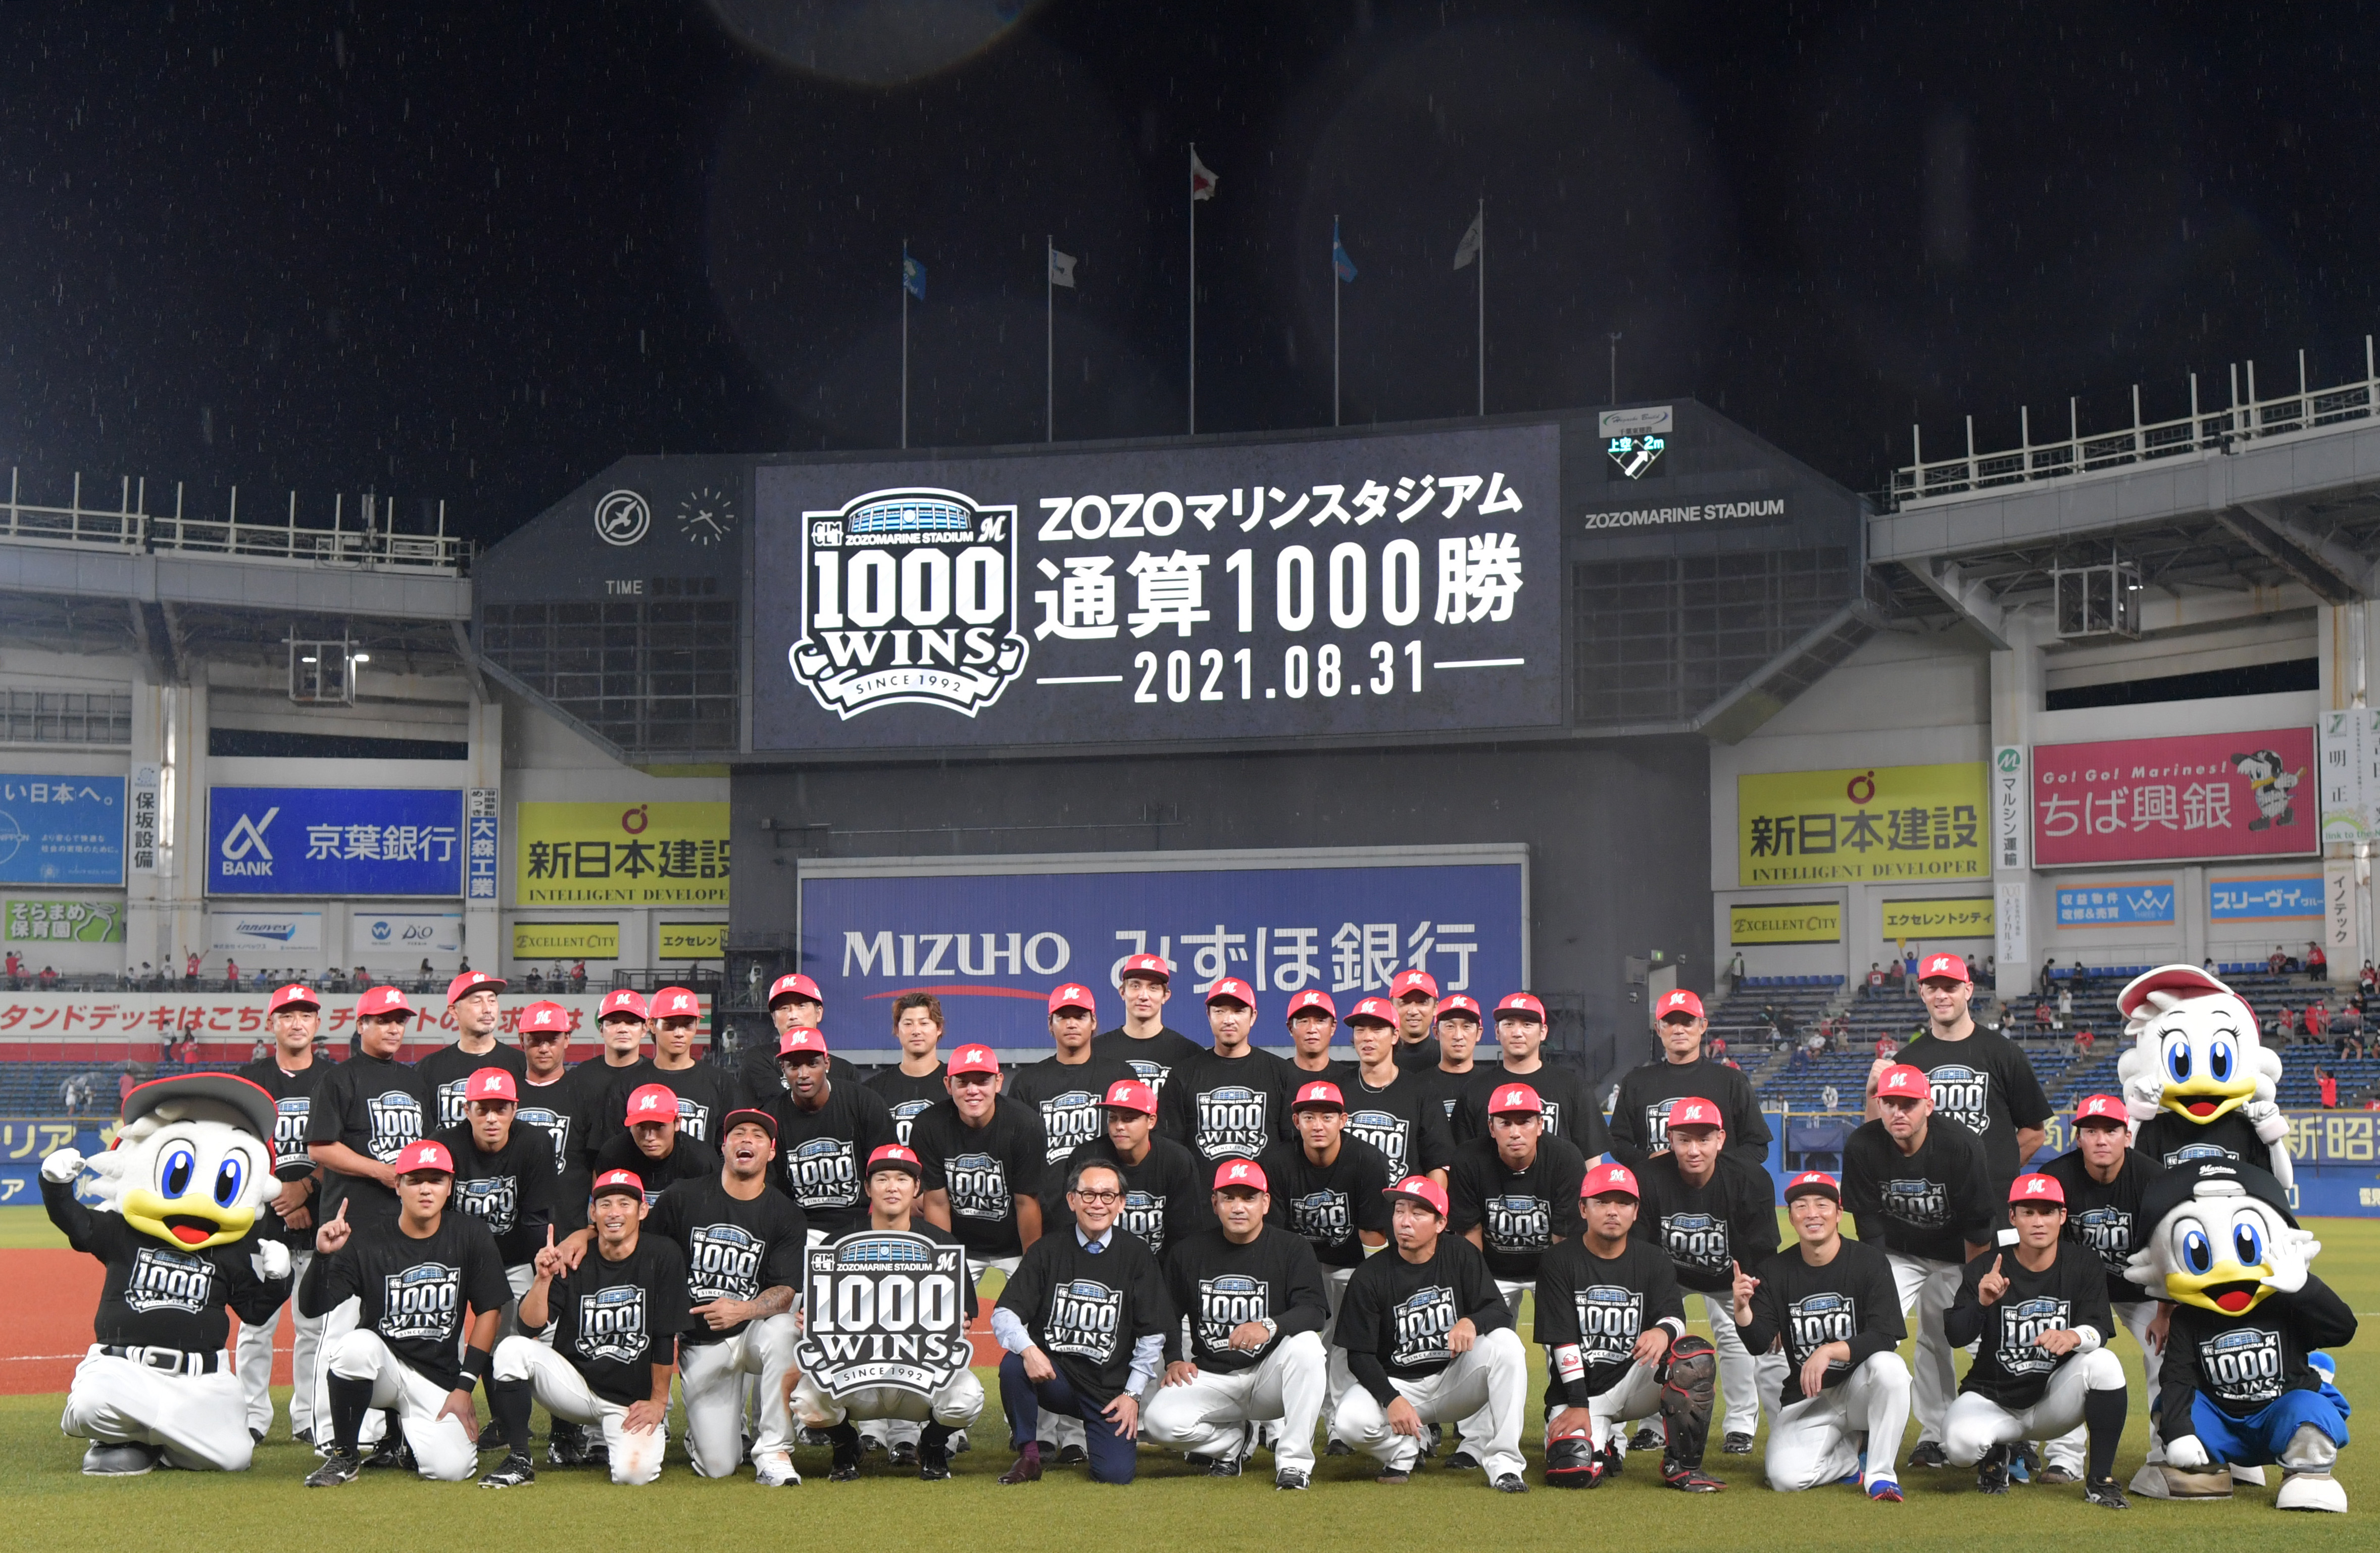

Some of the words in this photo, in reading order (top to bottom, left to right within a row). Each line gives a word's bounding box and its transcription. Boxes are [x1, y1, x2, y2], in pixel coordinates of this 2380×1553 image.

[1608, 436, 1631, 452] 上空
[1644, 435, 1664, 450] 2m
[1038, 472, 1522, 541] ZOZOマリンスタジアム
[1585, 506, 1701, 529] ZOZOMARINE
[1704, 499, 1784, 520] STADIUM
[845, 533, 921, 546] ZOZOMARINE
[922, 531, 973, 543] STADIUM
[606, 580, 642, 594] TIME
[814, 546, 1004, 628] 1000
[1034, 532, 1523, 641] 通算1000勝
[820, 627, 996, 667] WINS
[855, 674, 910, 695] SINCE
[918, 674, 962, 693] 1992
[1134, 640, 1421, 704] 2021.08.31
[2043, 771, 2076, 784] Go!
[2086, 768, 2119, 782] Go!
[2131, 761, 2226, 779] Marines!
[472, 790, 483, 817] めっき
[2040, 782, 2232, 837] ちば興銀
[134, 791, 155, 869] 保坂設備
[1750, 805, 1977, 858] 新日本建設
[2002, 777, 2017, 867] マルシン運輸
[2326, 831, 2341, 840] link
[2345, 831, 2354, 839] to
[305, 823, 457, 862] 京葉銀行
[222, 861, 273, 876] BANK
[471, 819, 495, 897] 大森工業
[528, 839, 729, 879] 新日本建設
[1753, 864, 1862, 881] INTELLIGENT
[1872, 860, 1977, 877] DEVELOPER
[529, 889, 636, 901] INTELLIGENT
[11, 903, 86, 922] そらまめ
[1887, 912, 1992, 926] エクセレントシティ
[2333, 876, 2348, 943] イノテック
[11, 921, 71, 939] 保育園
[1733, 918, 1804, 933] EXCELLENT
[1806, 916, 1837, 931] CITY
[516, 935, 584, 948] EXCELLENT
[586, 934, 616, 948] CITY
[842, 931, 1071, 978] MIZUHO
[1110, 920, 1478, 994] みずほ銀行
[1, 1006, 273, 1031] タンドデッキはこち
[1044, 1107, 1097, 1136] 1000
[1201, 1104, 1262, 1131] 1000
[1205, 1130, 1259, 1144] WINS
[789, 1156, 855, 1186] 1000
[945, 1171, 1004, 1197] 1000
[794, 1181, 853, 1196] WINS
[951, 1194, 1004, 1209] WINS
[1488, 1210, 1550, 1237] 1000
[691, 1242, 757, 1278] 1000
[836, 1263, 893, 1272] ZOZOMARINE
[894, 1263, 932, 1271] STADIUM
[133, 1263, 207, 1300] 1000
[695, 1271, 749, 1291] WINS
[390, 1283, 456, 1316] 1000
[812, 1274, 955, 1332] 1000
[1202, 1294, 1264, 1324] 1000
[392, 1311, 451, 1328] WINS
[1053, 1297, 1117, 1333] 1000
[1577, 1306, 1639, 1337] 1000
[817, 1333, 949, 1362] WINS
[1054, 1326, 1112, 1346] WINS
[843, 1367, 884, 1382] SINCE
[891, 1367, 923, 1381] 1992
[2205, 1347, 2277, 1385] 1000
